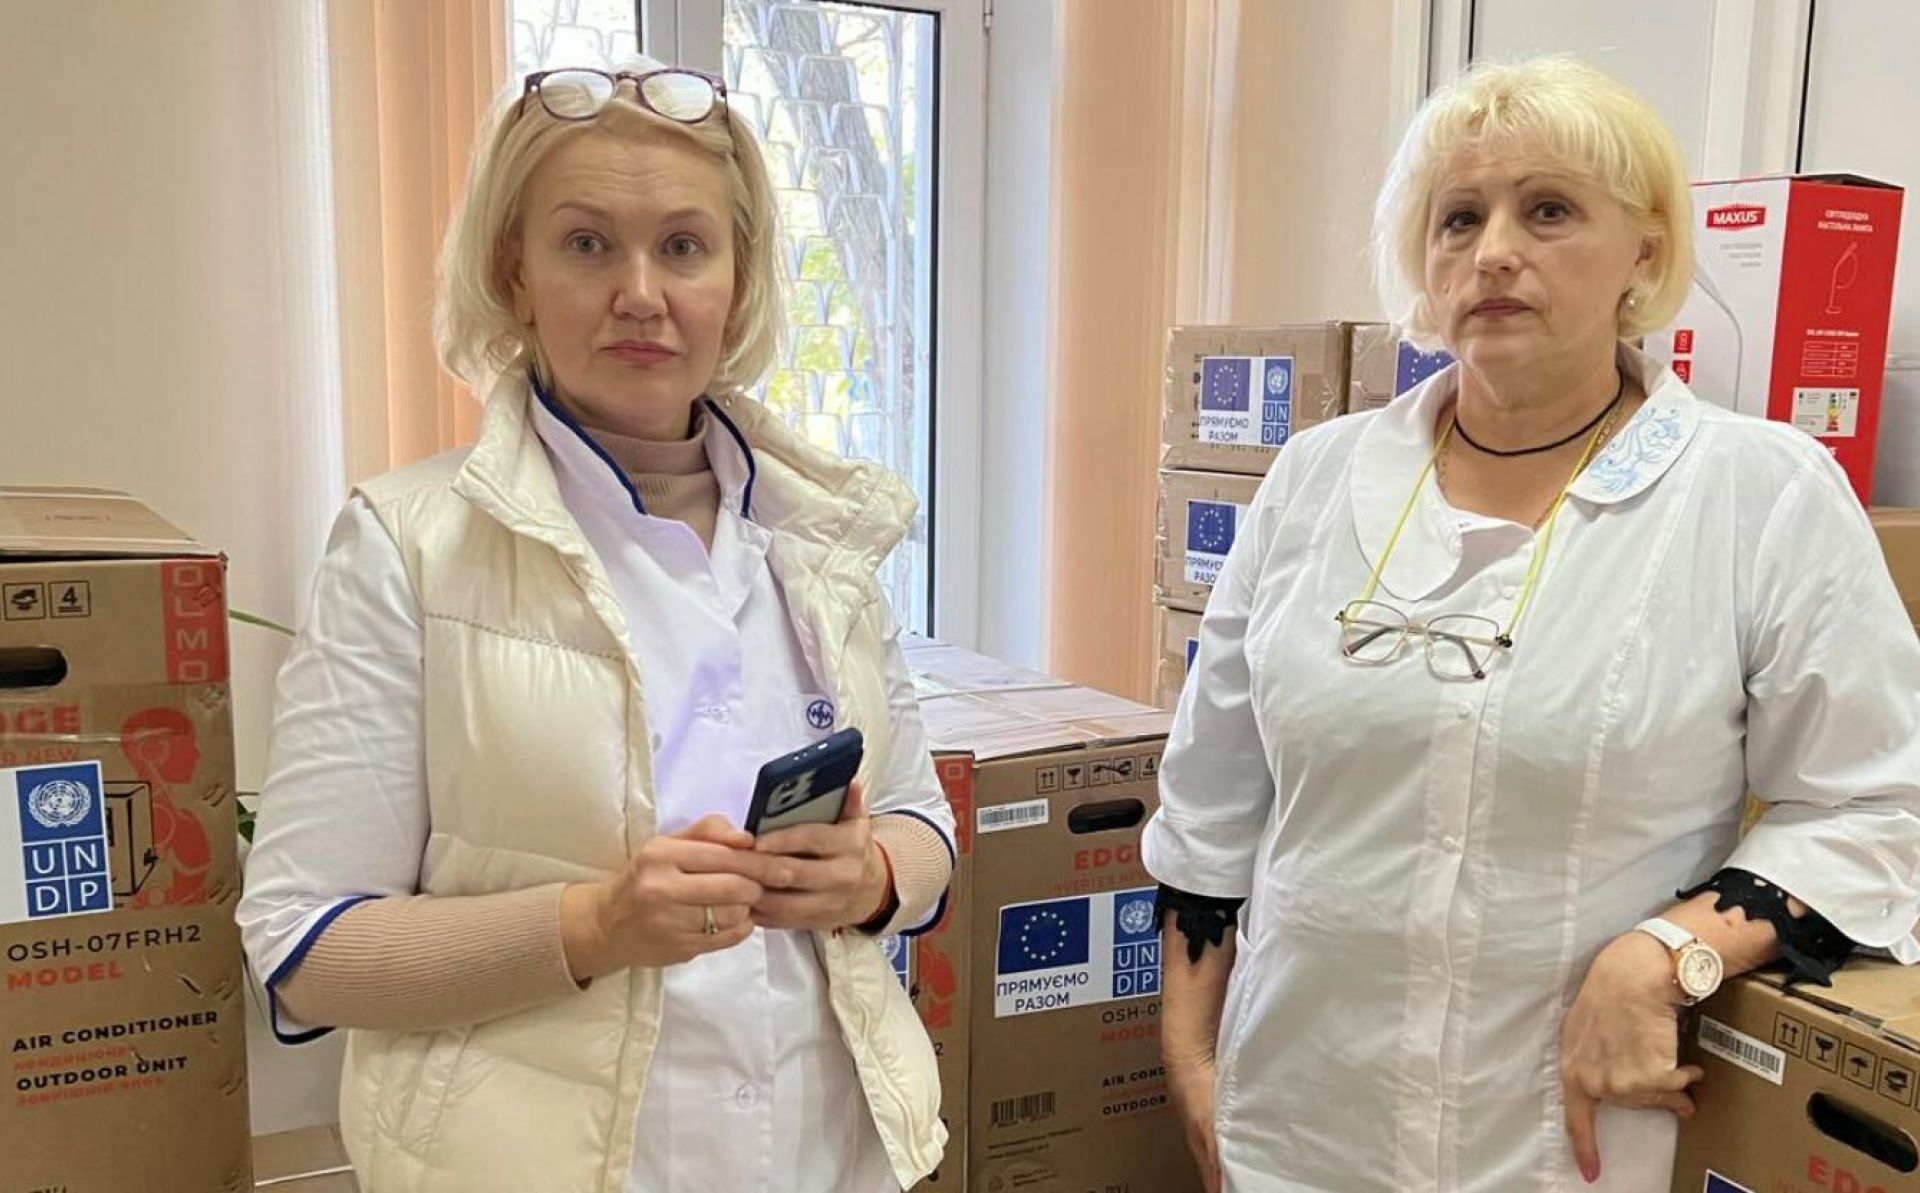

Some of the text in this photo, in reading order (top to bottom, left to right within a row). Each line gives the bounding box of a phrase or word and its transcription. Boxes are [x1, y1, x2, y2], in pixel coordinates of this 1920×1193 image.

[1712, 211, 1759, 224] MAXUS
[1186, 556, 1224, 571] ПРЯМУЄ
[1194, 571, 1217, 584] РАЗО
[0, 706, 81, 735] GE
[1074, 843, 1139, 871] EDG
[7, 925, 201, 961] OSH-07FRH2
[6, 961, 125, 991] MODEL
[997, 971, 1089, 996] ПРЯМУЄМО
[1015, 992, 1070, 1012] РАЗОМ
[13, 1010, 218, 1053] AIR CONDITIONER
[17, 1056, 188, 1091] OUTDOOR UNIT
[1129, 1066, 1167, 1082] COND
[1102, 1094, 1167, 1116] OUTDOOR
[1807, 1153, 1886, 1193] ED
